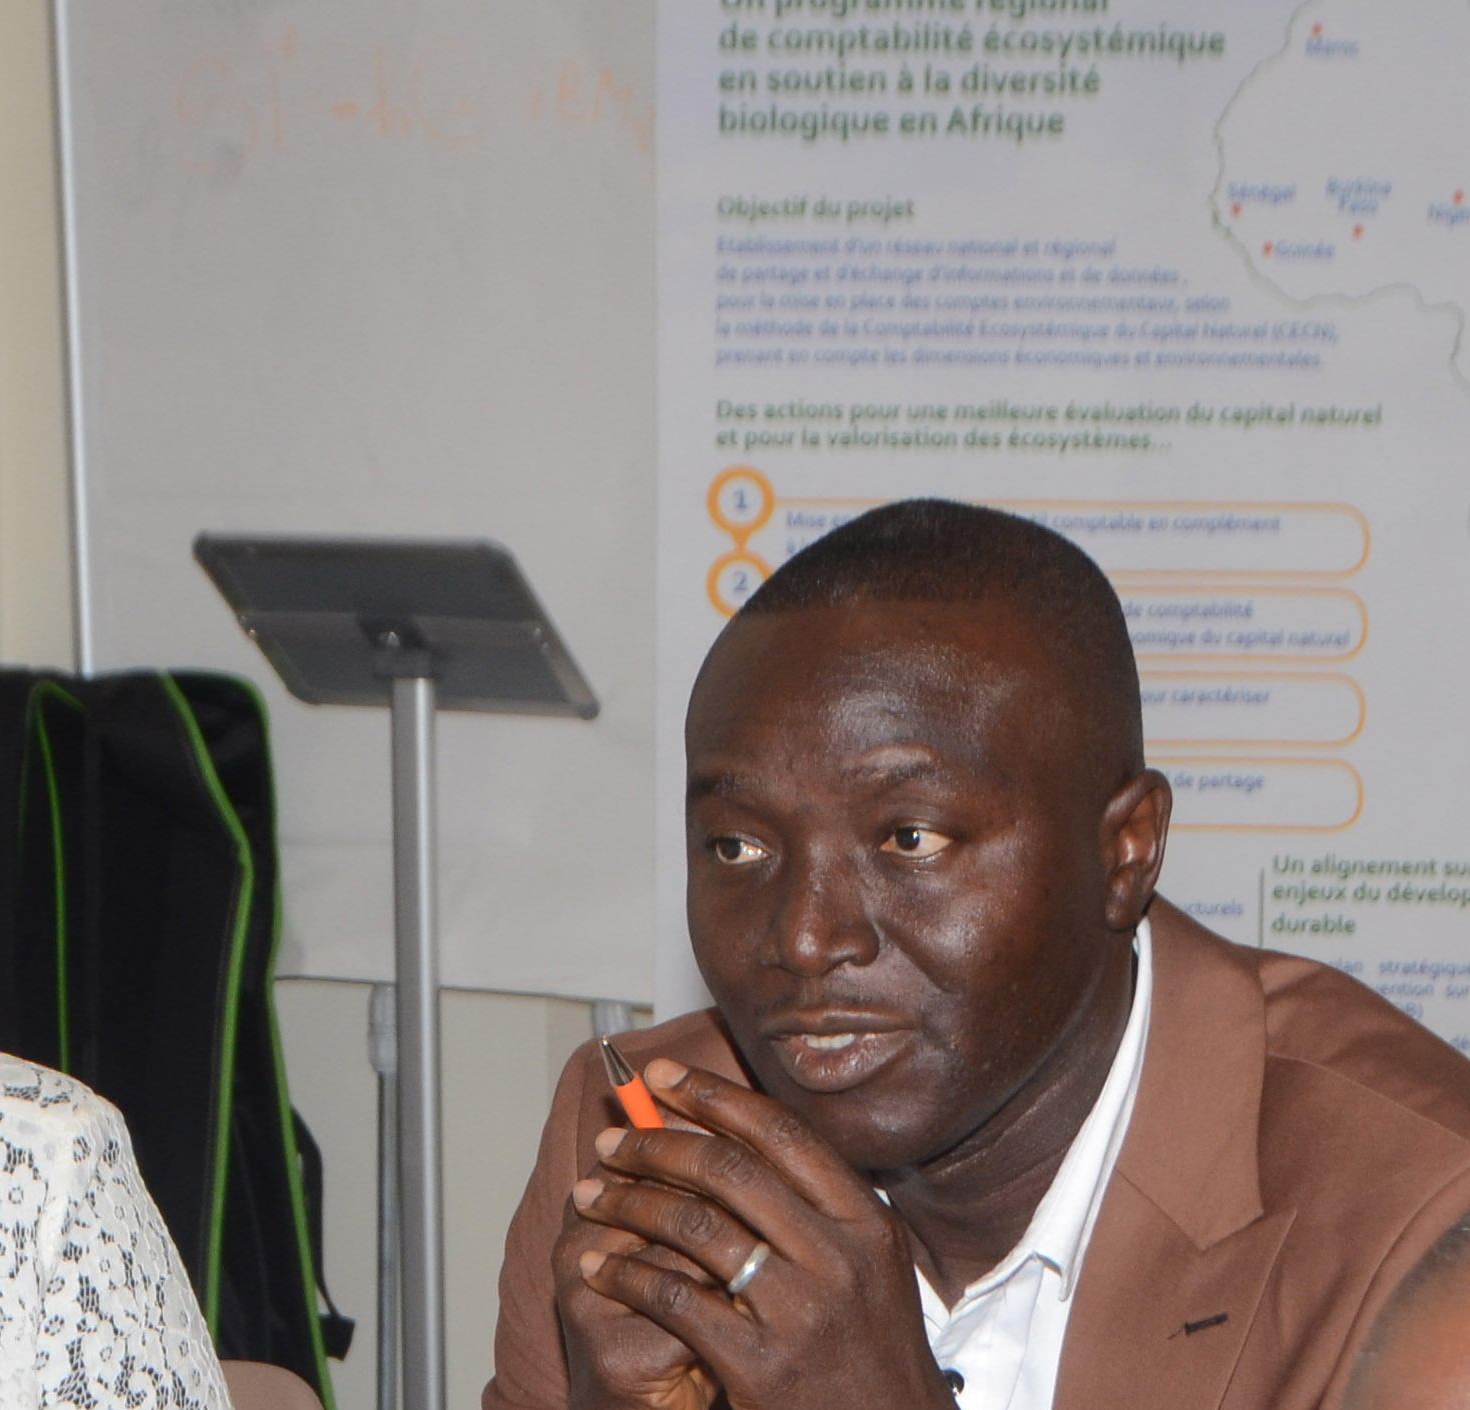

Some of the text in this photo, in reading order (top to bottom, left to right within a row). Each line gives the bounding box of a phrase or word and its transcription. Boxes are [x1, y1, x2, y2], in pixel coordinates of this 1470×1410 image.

[719, 19, 1226, 63] de comptabilité écosystémique
[719, 62, 1101, 94] en soutien à la diversité
[719, 104, 1066, 142] biologique en Afrique
[718, 197, 915, 223] Objectif du projet
[717, 400, 1384, 429] Des actions pour une meilleure évaluation du capital naturel
[716, 428, 738, 447] et
[744, 430, 796, 451] pour
[802, 426, 821, 447] la
[827, 426, 958, 449] valorisation
[964, 426, 1003, 449] des
[733, 488, 748, 510] 1
[786, 510, 826, 529] Mise
[1053, 513, 1145, 535] comptable
[1173, 512, 1282, 535] complément
[732, 571, 748, 592] 2
[1148, 601, 1254, 621] comptabilité
[1228, 629, 1284, 648] capital
[1288, 630, 1351, 647] naturel
[1142, 686, 1271, 704] our caractériser
[1198, 774, 1265, 793] partage
[1272, 855, 1304, 876] Un
[1311, 856, 1437, 881] alignement
[1271, 881, 1346, 906] enjeux
[1352, 881, 1382, 903] du
[1271, 914, 1357, 936] durable
[1445, 984, 1470, 998] sur
